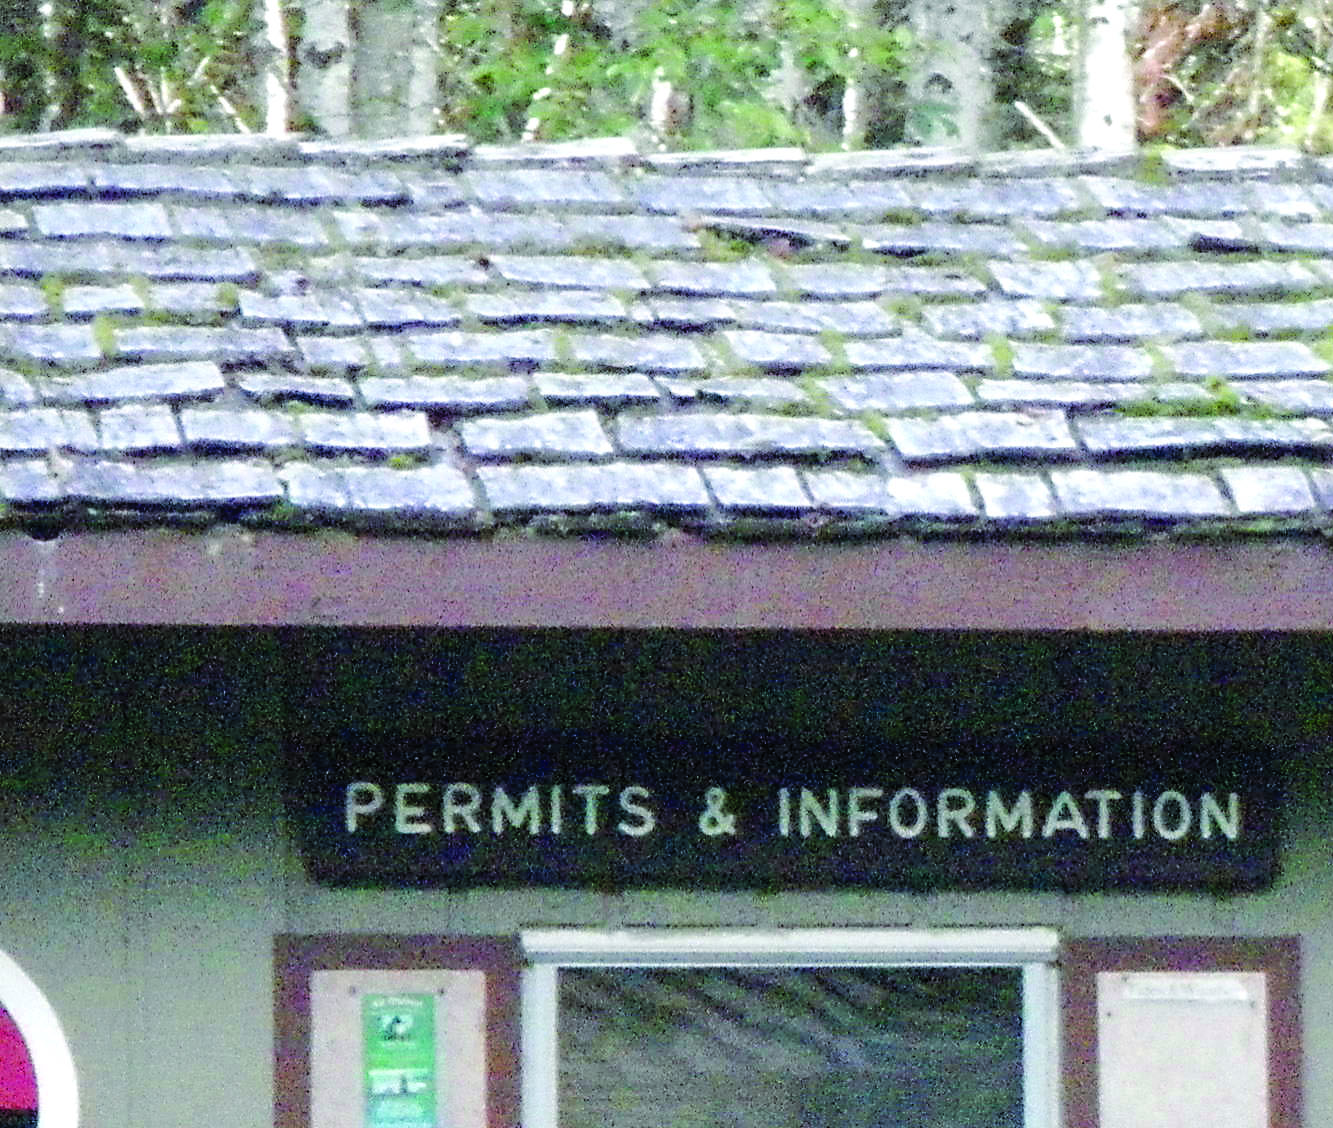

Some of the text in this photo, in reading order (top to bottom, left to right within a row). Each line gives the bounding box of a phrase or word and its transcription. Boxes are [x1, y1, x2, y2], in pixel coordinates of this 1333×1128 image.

[344, 781, 1242, 841] PERMITS & INFORMATION
